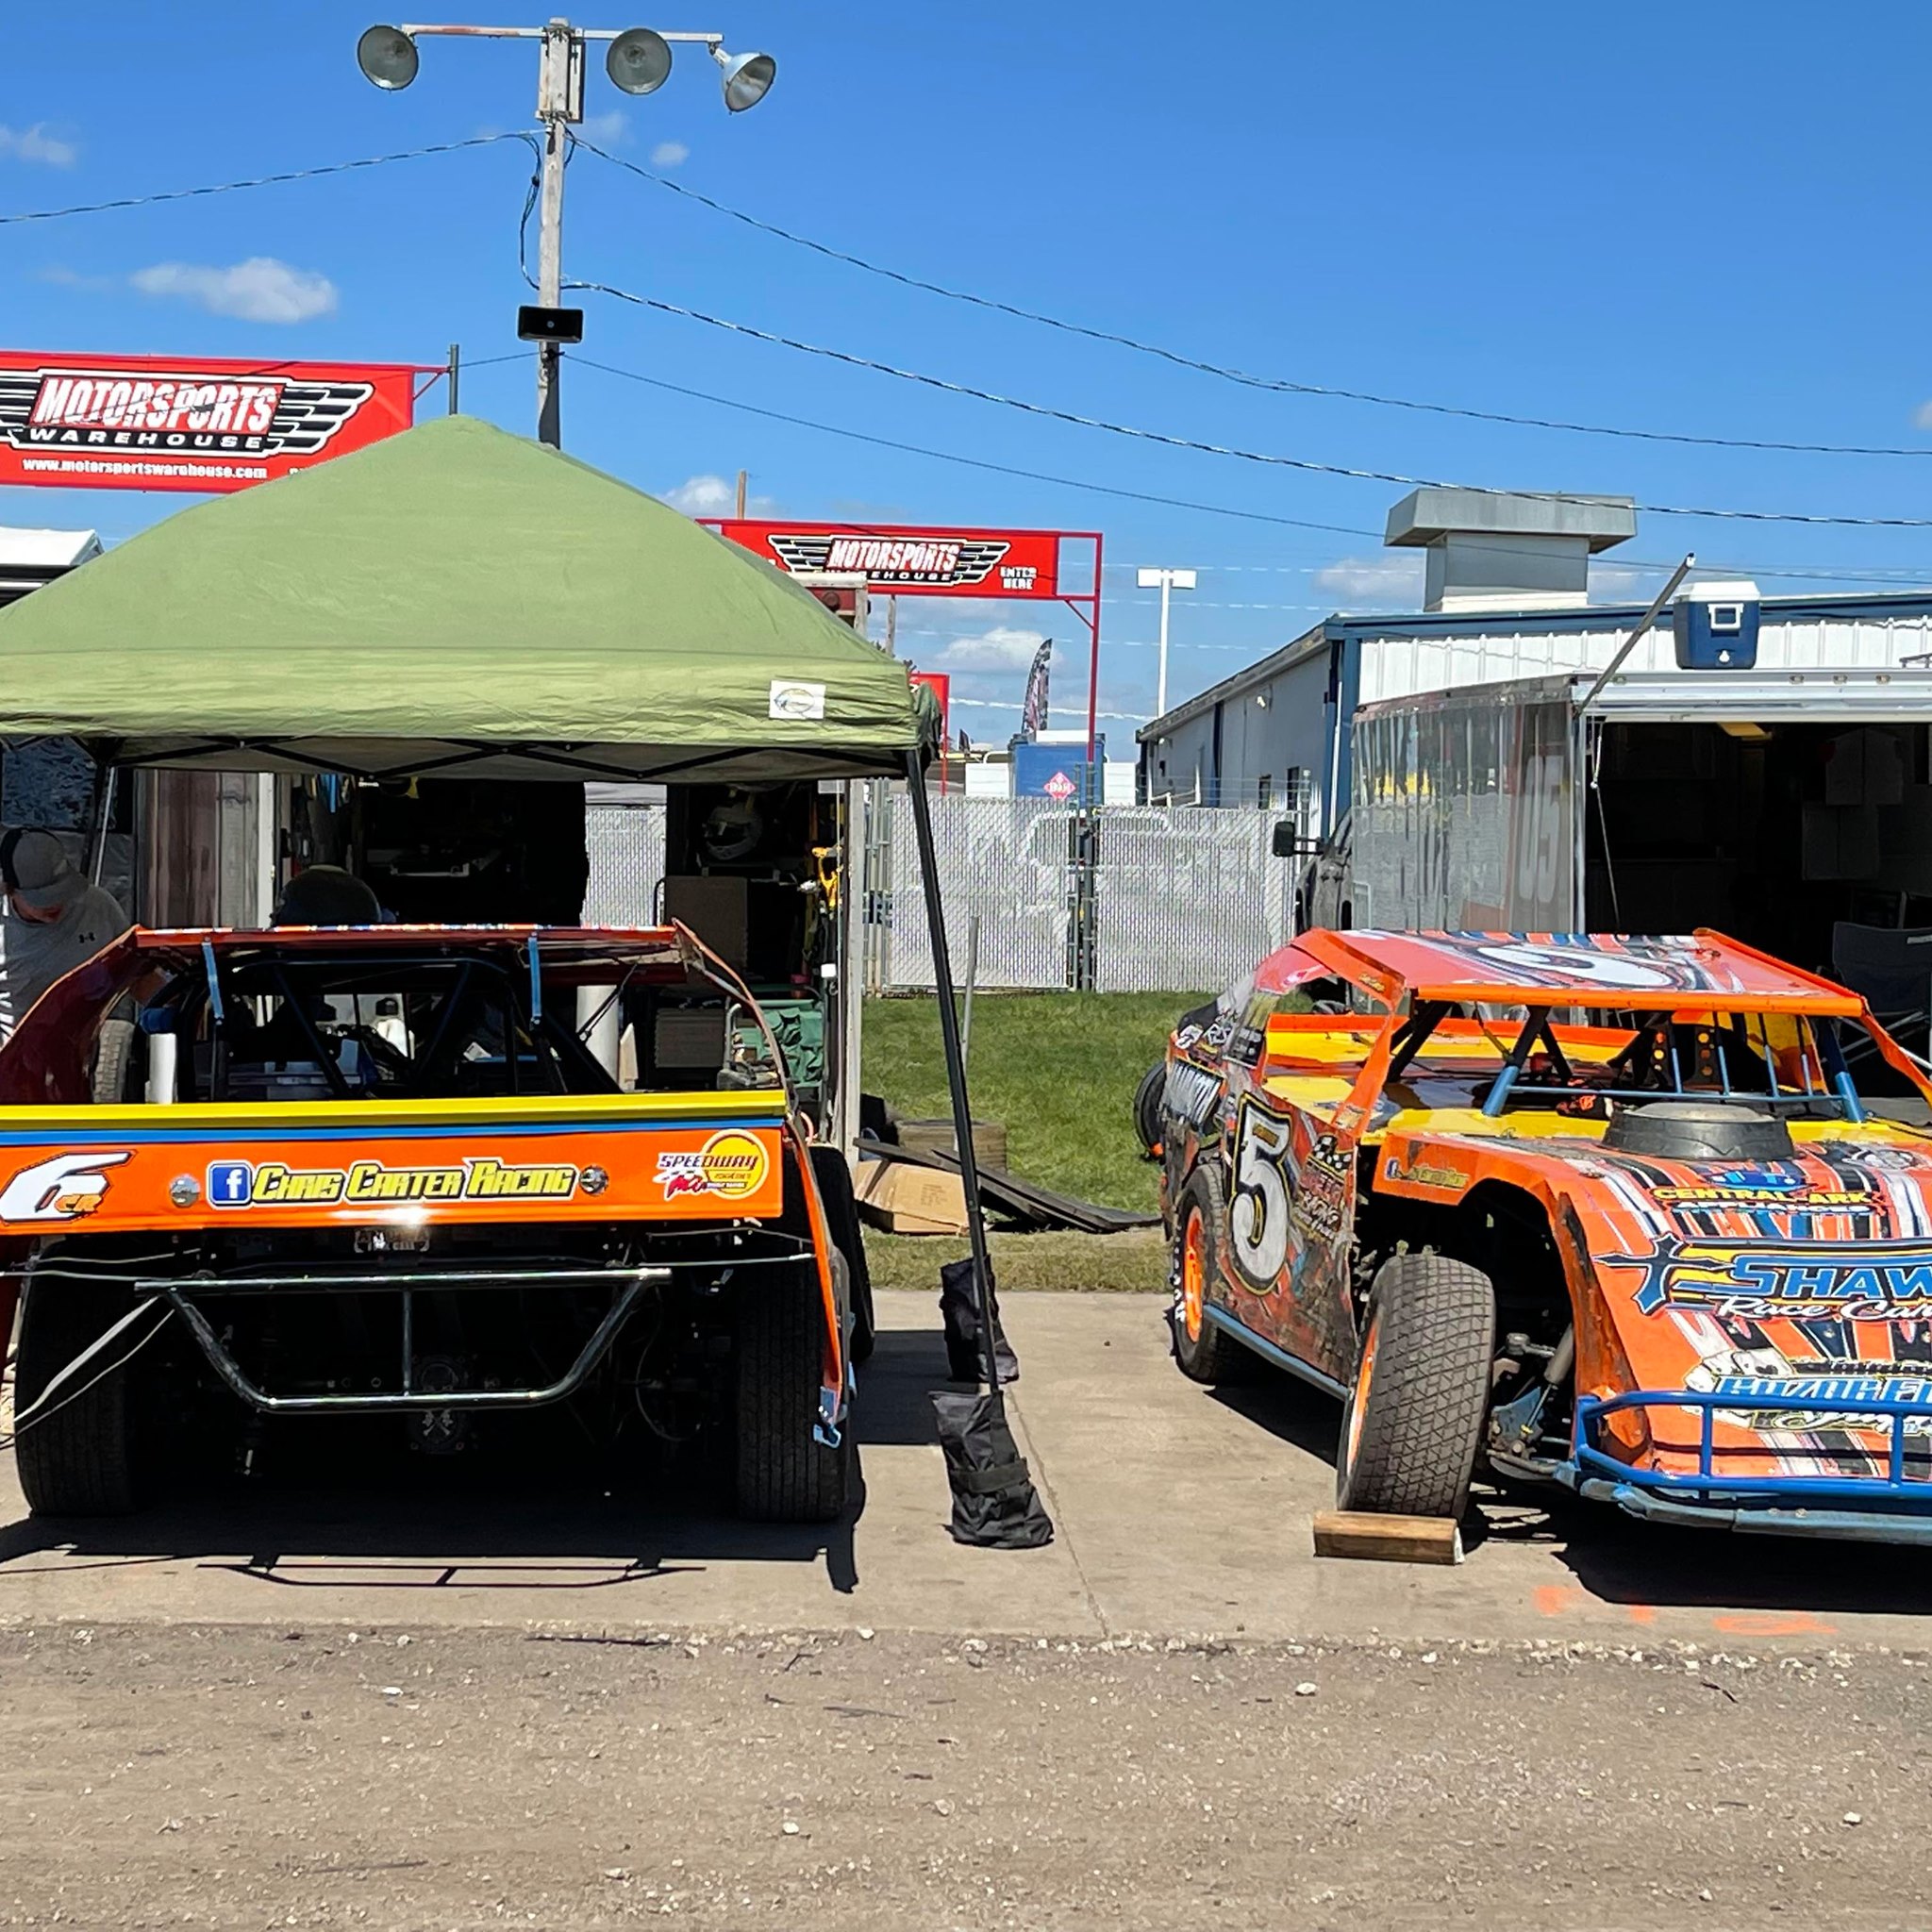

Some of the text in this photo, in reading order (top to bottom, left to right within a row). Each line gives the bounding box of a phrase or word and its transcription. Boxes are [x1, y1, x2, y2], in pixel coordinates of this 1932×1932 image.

[33, 376, 279, 433] MOTORSPORTS
[29, 428, 264, 450] WAREHOUSE
[827, 540, 960, 572] MOTORSPORTS
[1000, 566, 1037, 578] ENTER
[1003, 577, 1033, 590] HERE
[659, 1155, 758, 1171] SPEEDWAY
[1653, 1189, 1873, 1204] CENTRAL ARK
[1713, 1295, 1832, 1319] Race
